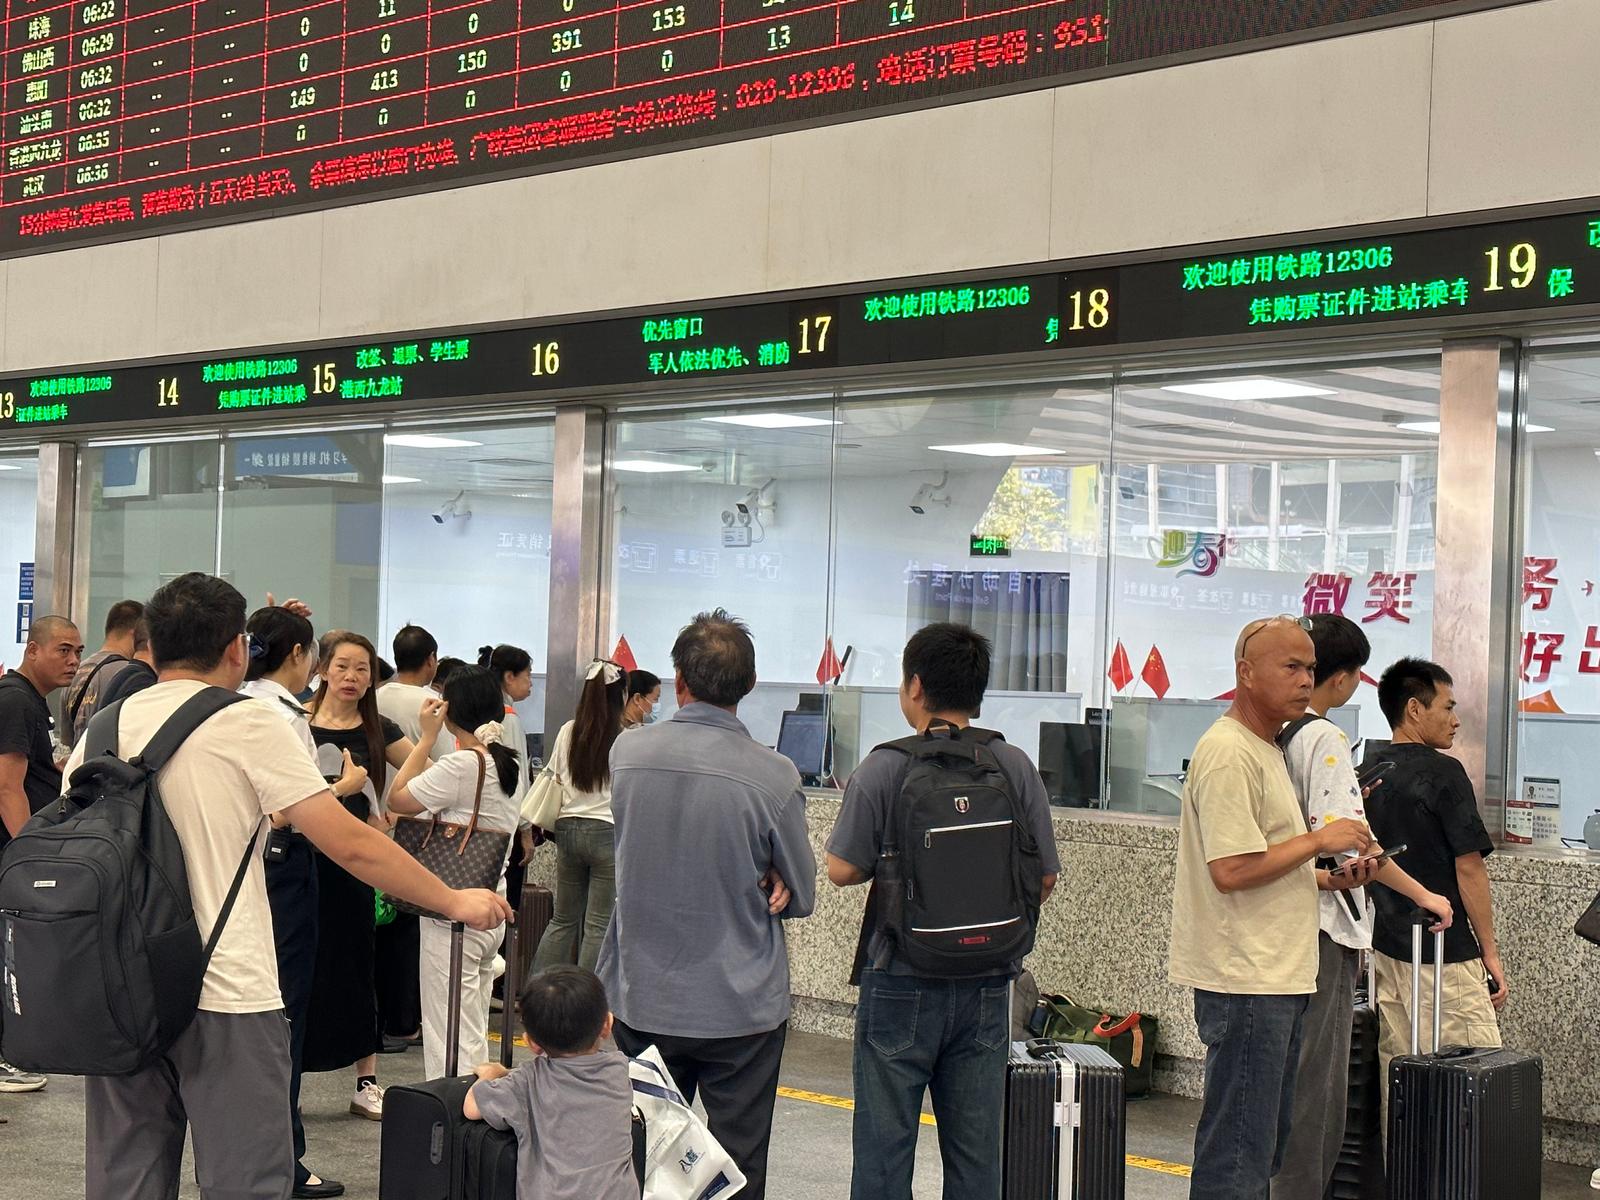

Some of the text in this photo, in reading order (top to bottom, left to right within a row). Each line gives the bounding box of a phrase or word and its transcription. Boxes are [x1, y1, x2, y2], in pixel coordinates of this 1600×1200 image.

[83, 0, 115, 24] 06:22
[22, 32, 114, 73] 佛山西 06:29
[79, 98, 112, 121] 06:32
[299, 53, 309, 72] 0
[381, 34, 391, 54] 0
[468, 13, 479, 34] 0
[80, 65, 113, 89] 06:32
[301, 17, 311, 36] 0
[290, 87, 316, 109] 149
[370, 69, 399, 91] 413
[458, 50, 488, 73] 150
[552, 29, 582, 53] 391
[652, 6, 686, 31] 153
[465, 90, 476, 109] 0
[560, 71, 571, 92] 0
[661, 50, 673, 72] 0
[767, 25, 791, 51] 13
[888, 0, 915, 26] 14
[1182, 246, 1393, 292] 欢迎使用铁路12306
[1483, 243, 1537, 292] 19
[1548, 268, 1574, 297] 保
[864, 286, 1030, 321] 欢迎使用铁路12306
[1068, 288, 1109, 331] 18
[1248, 276, 1469, 325] 凭购票证件进站乘车
[642, 317, 703, 343] 优先窗口
[798, 315, 832, 354] 17
[203, 359, 298, 383] 欢迎使用铁路12306
[356, 339, 470, 369] 改签、退票、学生票
[531, 342, 560, 376] 16
[648, 341, 790, 375] 军人依法优先、消防
[30, 376, 112, 397] 欢迎使用铁路12306
[158, 378, 178, 406] 14
[312, 363, 336, 394] 15
[16, 403, 68, 422] 证件进站乘车
[1303, 571, 1417, 623] 微笑
